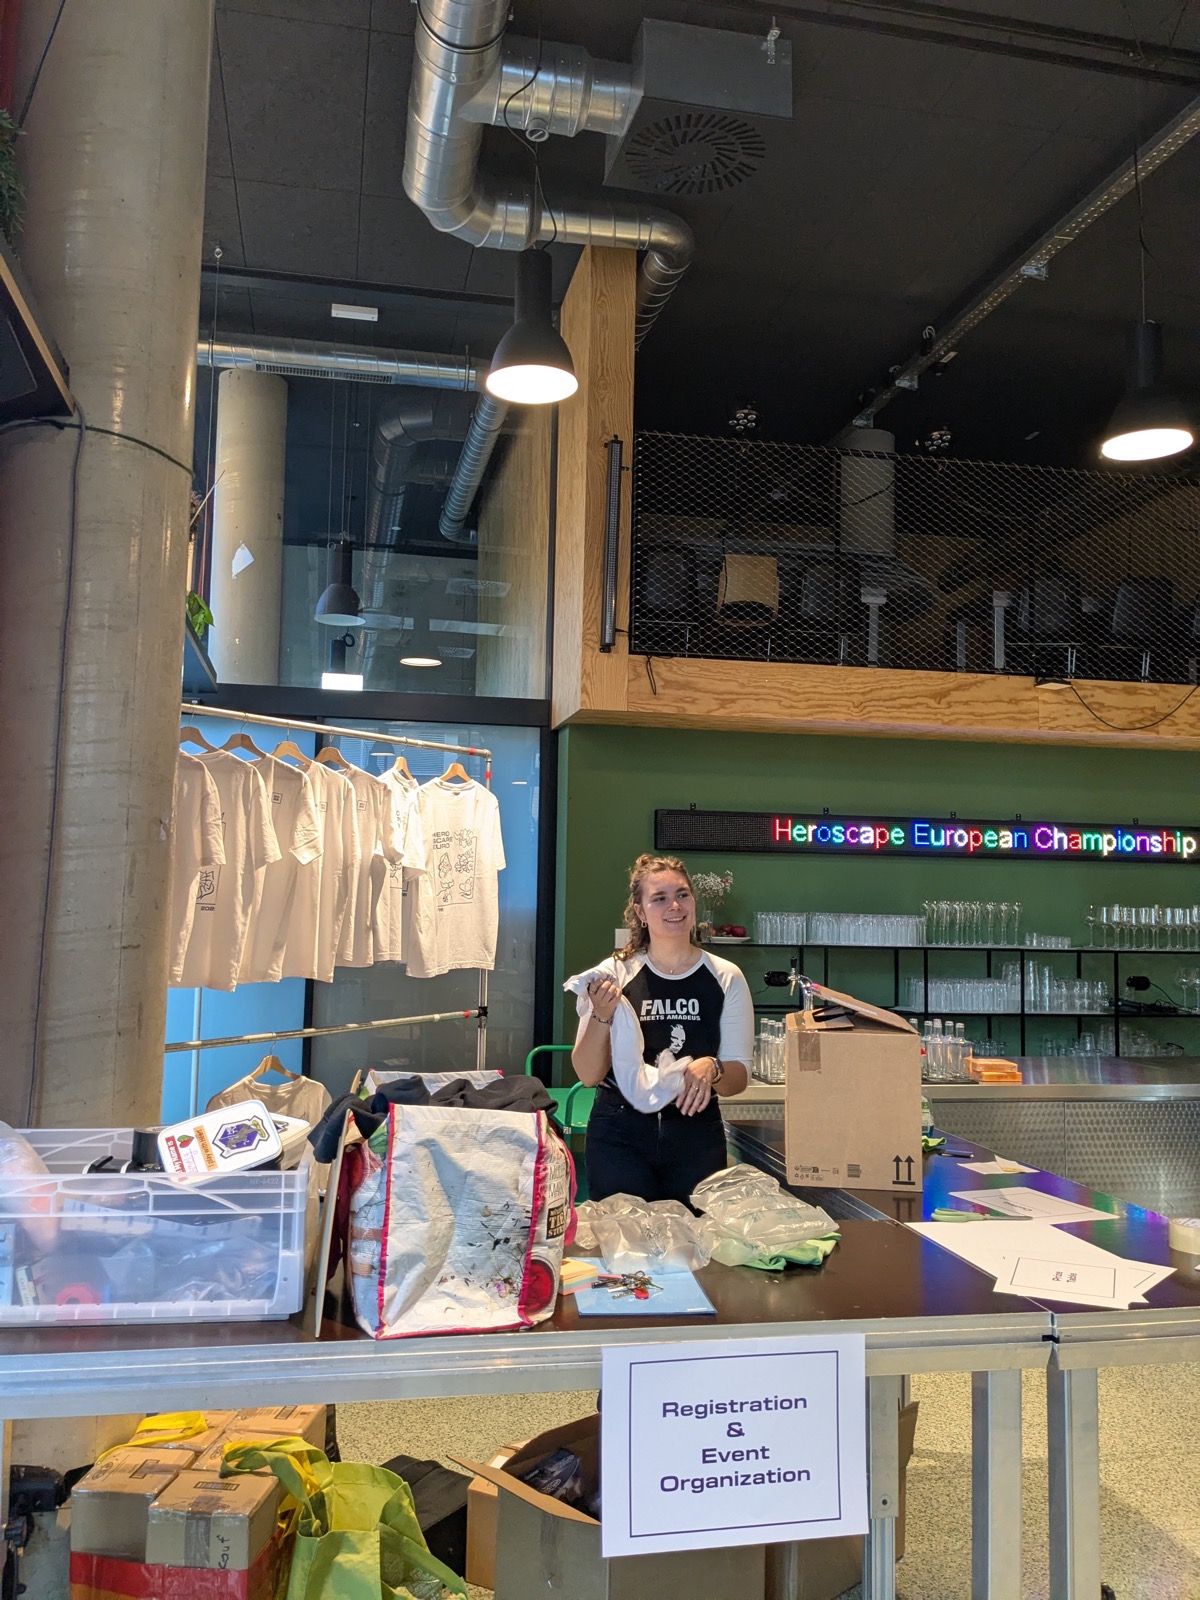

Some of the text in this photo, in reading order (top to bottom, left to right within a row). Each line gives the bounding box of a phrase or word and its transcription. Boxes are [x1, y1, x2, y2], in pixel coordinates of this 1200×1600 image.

[774, 818, 1197, 859] Heroscape European Championship
[640, 998, 700, 1016] FALCO
[640, 1014, 701, 1022] MEETS AMADEUS
[662, 1395, 808, 1419] Registration
[726, 1422, 745, 1438] &
[701, 1445, 770, 1464] Event
[660, 1467, 811, 1493] Organization
